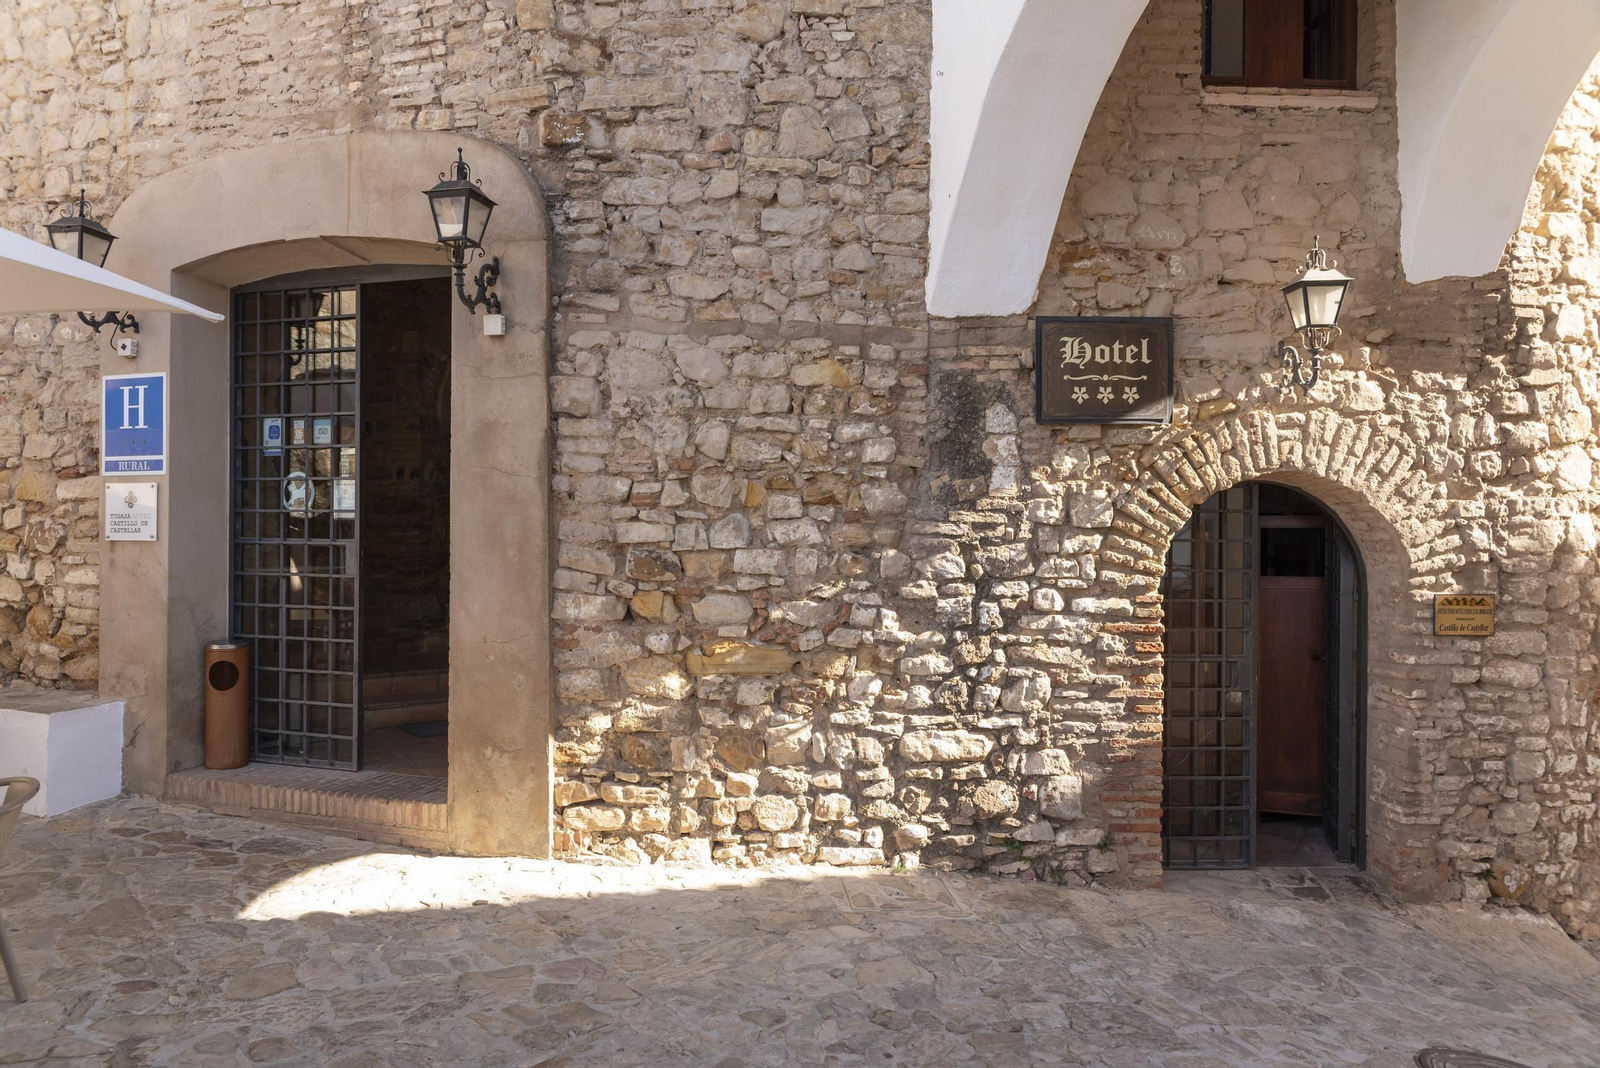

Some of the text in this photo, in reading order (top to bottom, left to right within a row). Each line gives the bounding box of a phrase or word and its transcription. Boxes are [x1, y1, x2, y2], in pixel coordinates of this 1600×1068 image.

[1059, 336, 1152, 369] Hotel
[119, 385, 148, 429] H
[118, 461, 150, 471] RURAL
[1439, 623, 1489, 632] Castillo de Castellar
